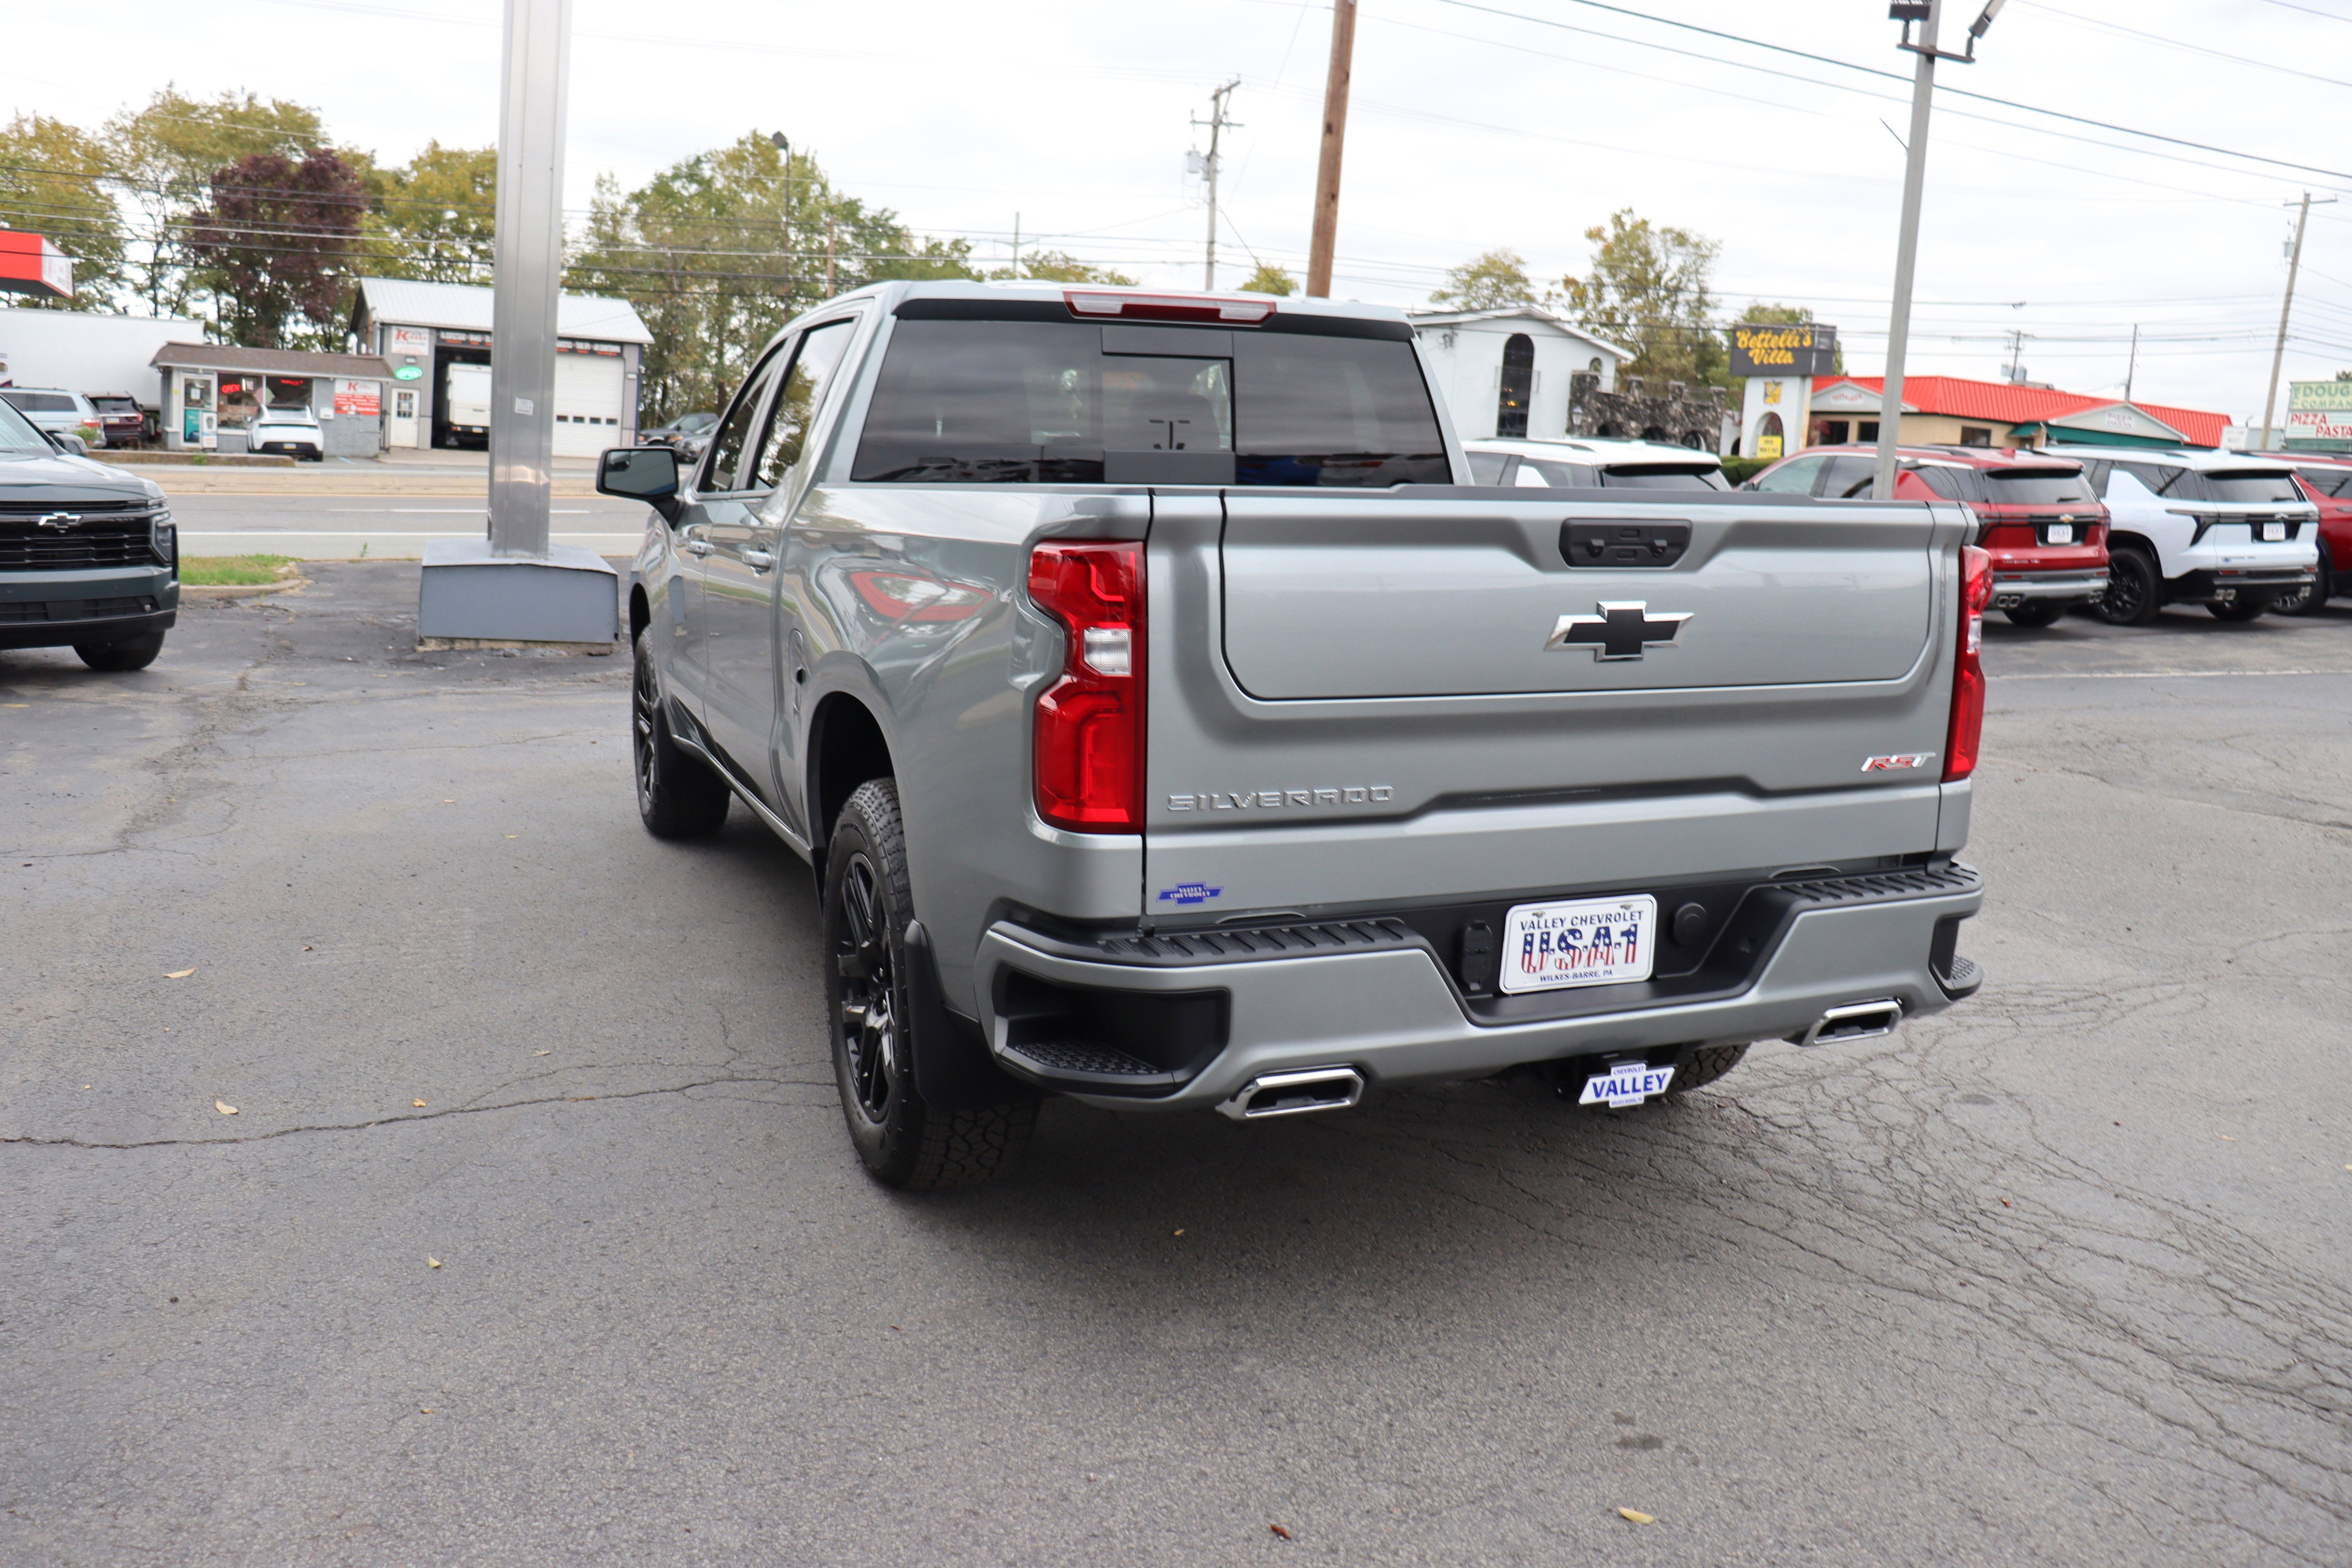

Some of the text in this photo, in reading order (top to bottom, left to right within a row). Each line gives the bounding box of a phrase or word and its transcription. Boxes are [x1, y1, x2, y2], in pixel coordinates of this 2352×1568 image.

[1748, 347, 1794, 365] Villa
[221, 384, 241, 394] OPEN
[2291, 413, 2327, 425] PIZZA
[2316, 425, 2352, 438] PASTA
[1860, 751, 1937, 772] RST
[1167, 785, 1394, 811] SILVERADO
[1520, 911, 1644, 931] VALLEY CHEVROLET
[1613, 1066, 1645, 1075] CHEVROLET
[1592, 1073, 1667, 1098] VALLEY
